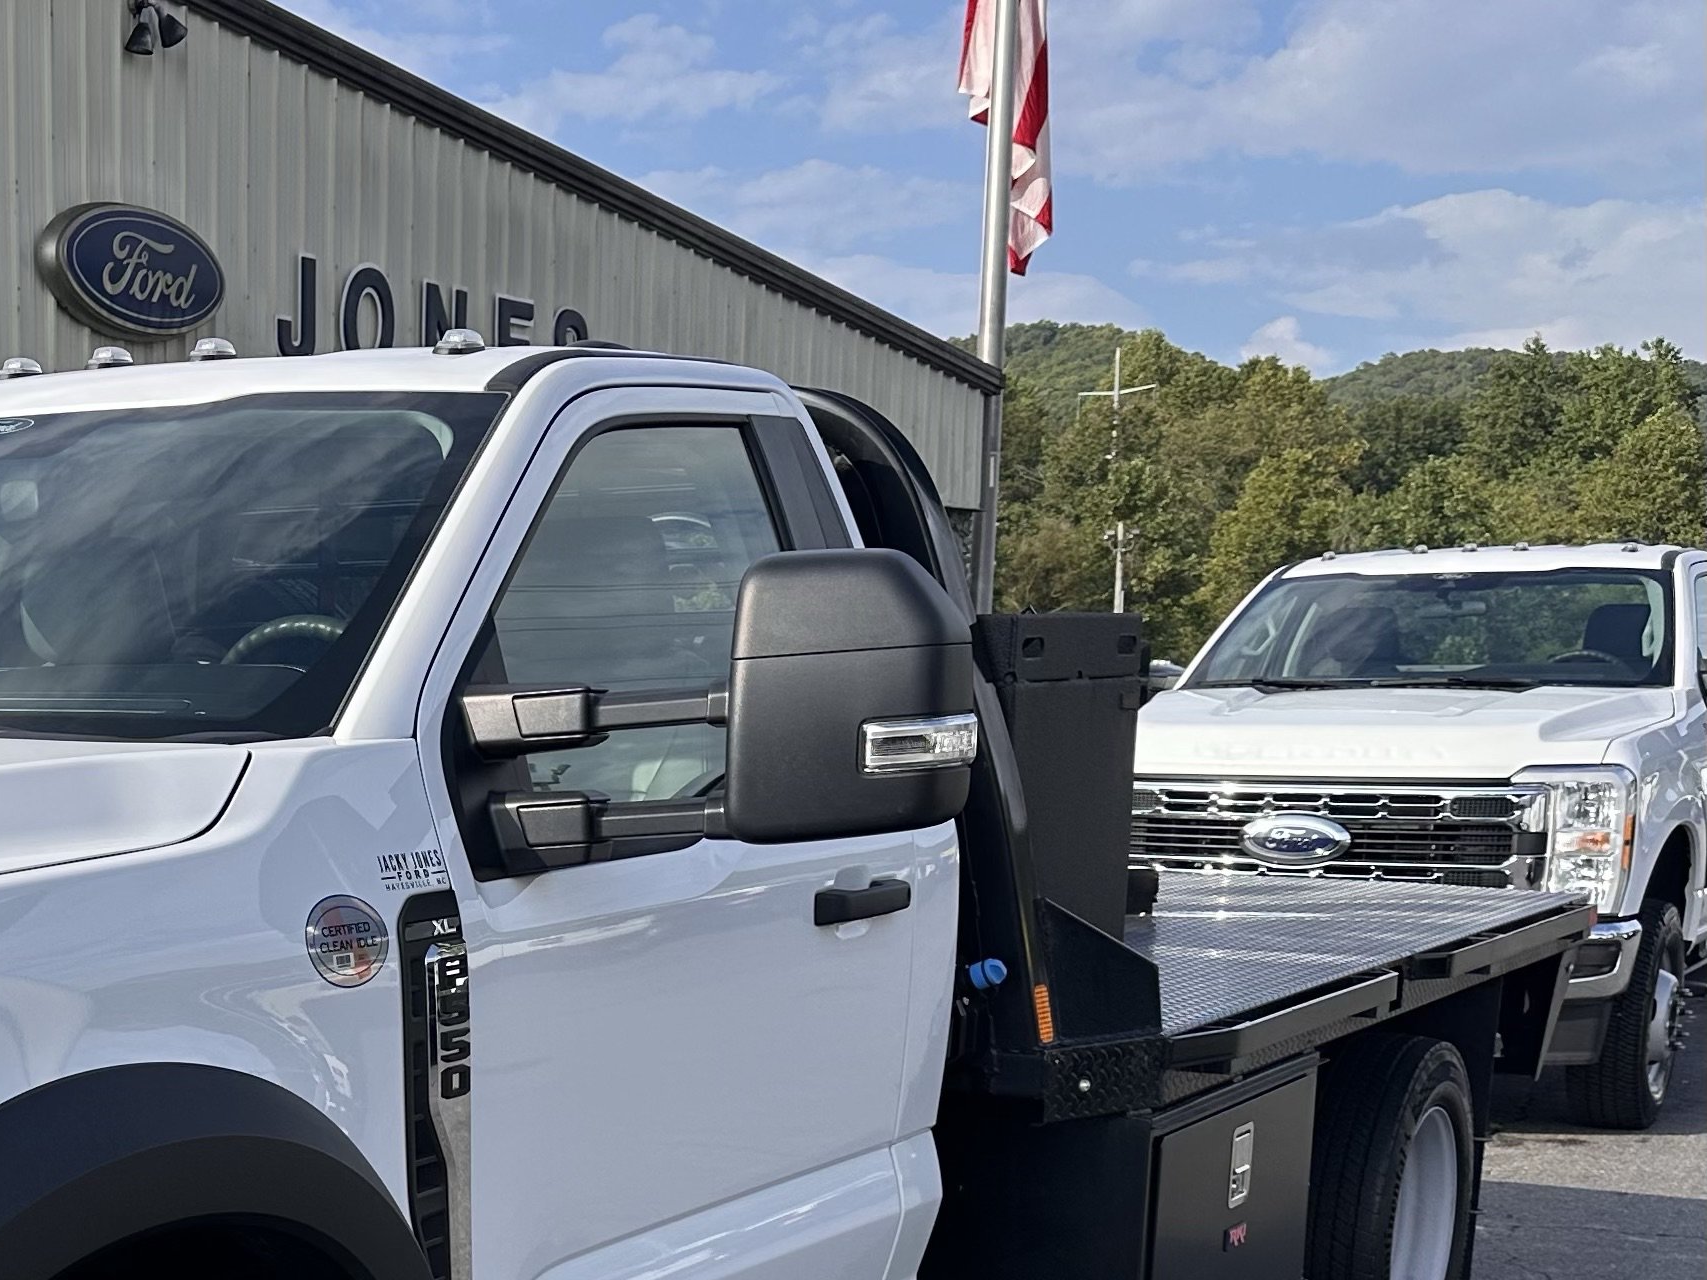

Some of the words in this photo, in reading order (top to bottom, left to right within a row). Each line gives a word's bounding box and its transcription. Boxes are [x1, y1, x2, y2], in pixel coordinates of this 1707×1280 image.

[102, 230, 197, 310] Ford
[377, 852, 410, 873] JACKY
[411, 849, 442, 869] JONES
[397, 869, 430, 881] FORD
[321, 921, 371, 938] CERTIFIED
[431, 918, 457, 936] XL
[319, 939, 353, 954] CLEAN
[356, 935, 379, 949] IDLE
